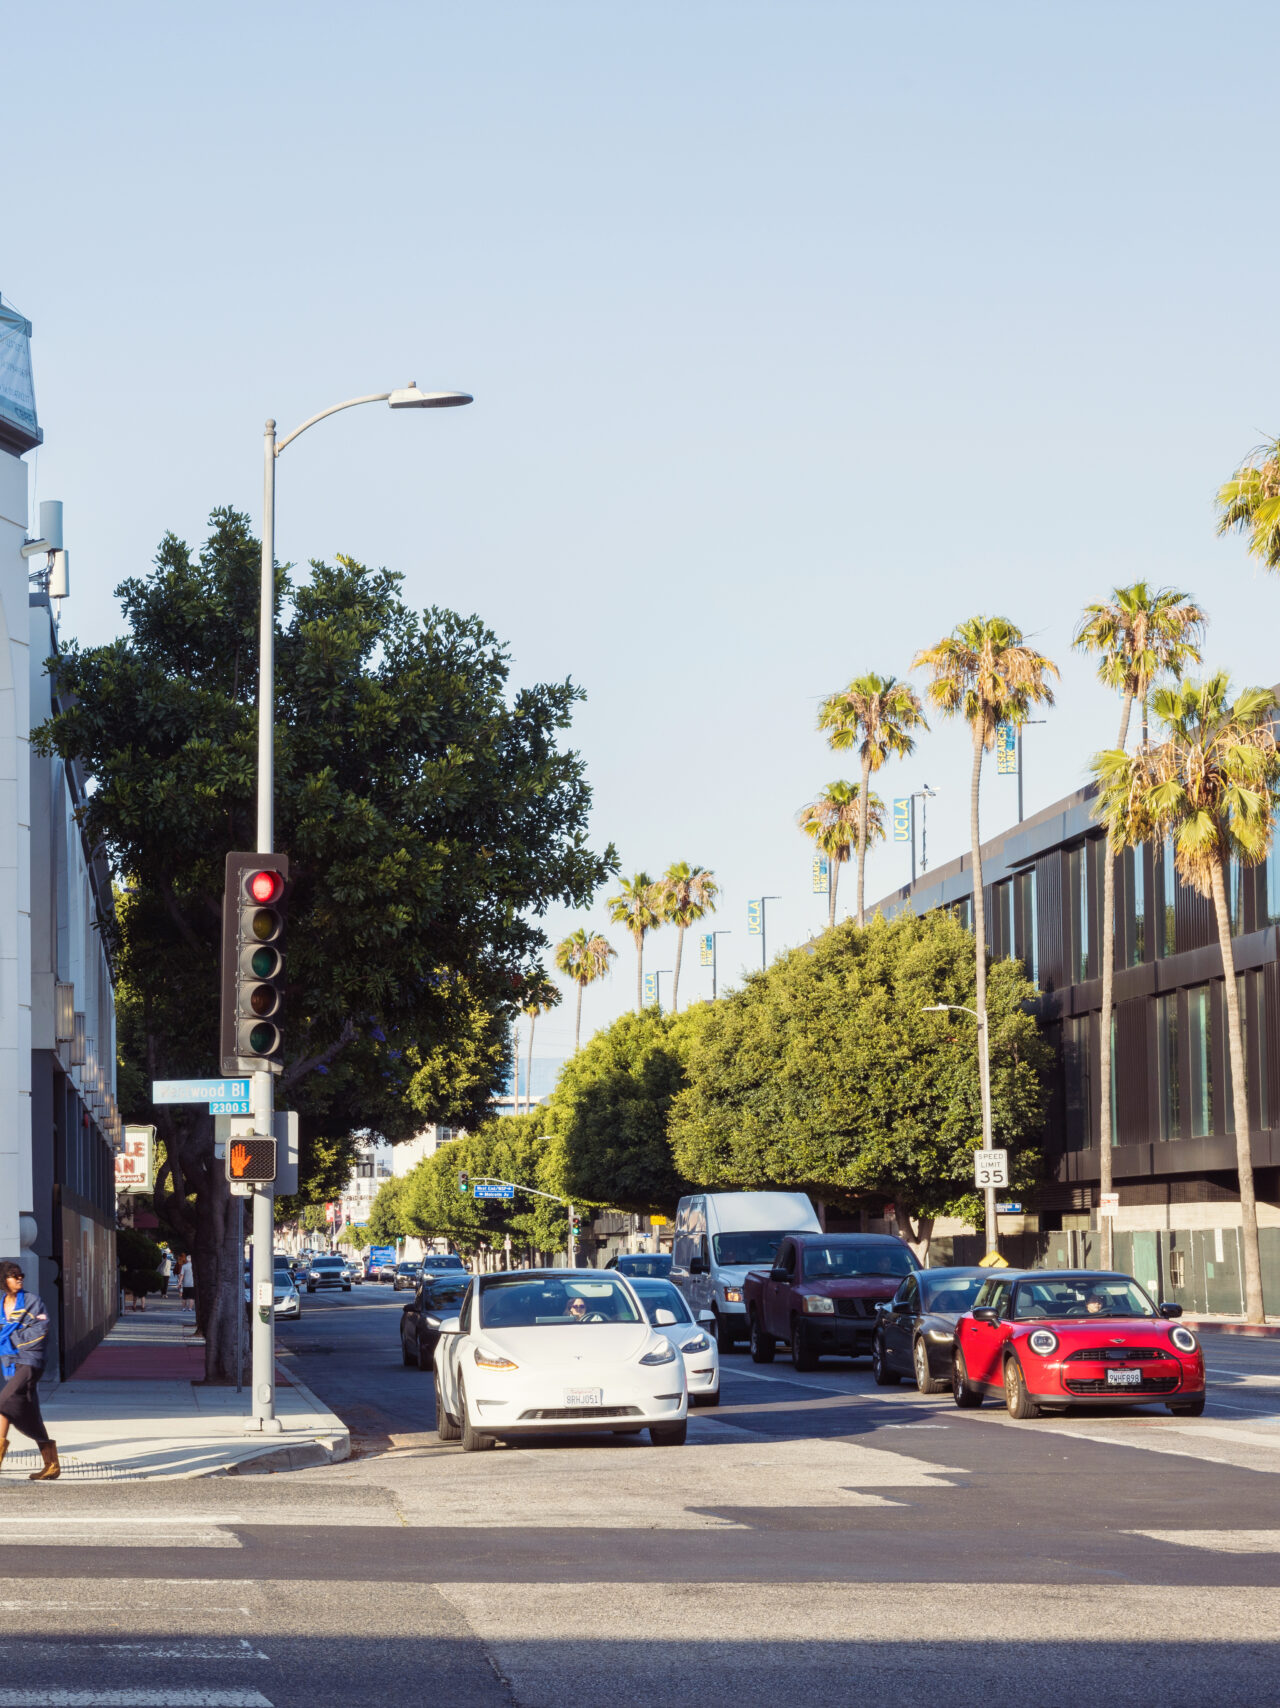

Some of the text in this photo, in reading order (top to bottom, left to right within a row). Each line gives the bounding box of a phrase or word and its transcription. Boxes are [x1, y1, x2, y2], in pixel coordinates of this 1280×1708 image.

[1007, 749, 1017, 773] PARK
[894, 799, 909, 841] UCLA
[748, 901, 761, 934] UCLA
[646, 973, 656, 1002] UCLA
[231, 1082, 245, 1097] Bl
[212, 1102, 247, 1113] 2300 S
[980, 1170, 1004, 1184] 35
